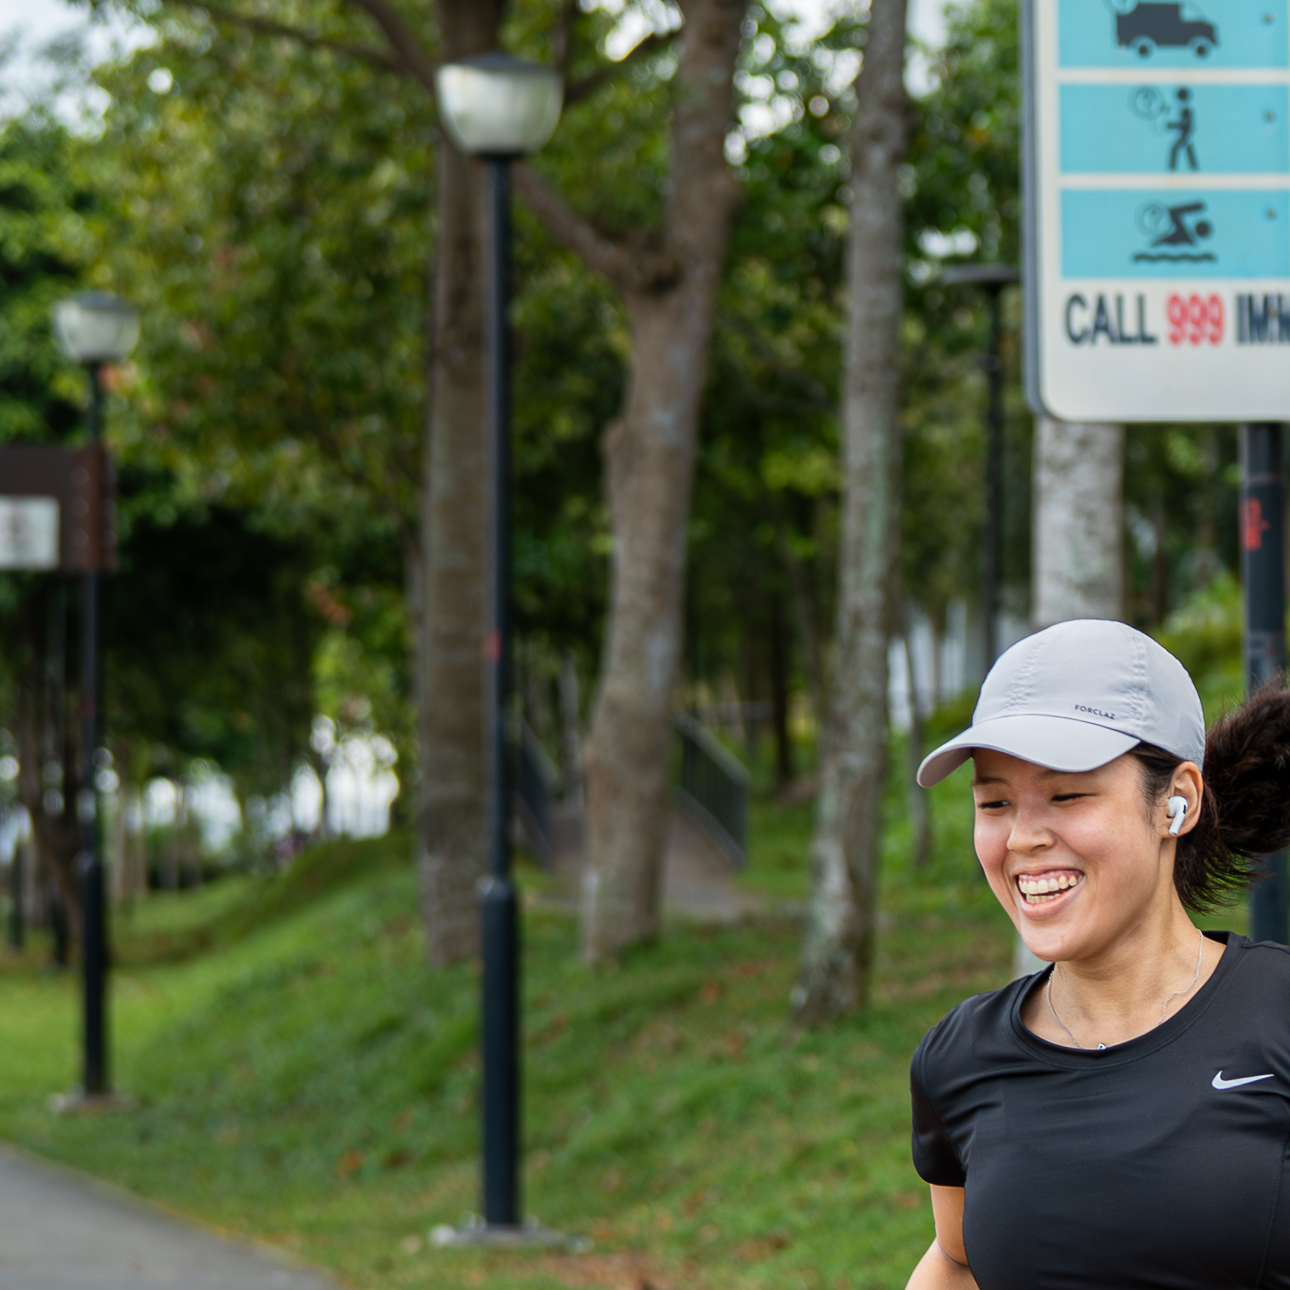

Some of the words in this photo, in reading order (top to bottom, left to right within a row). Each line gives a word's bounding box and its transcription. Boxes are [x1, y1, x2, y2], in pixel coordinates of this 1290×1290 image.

[1065, 293, 1156, 346] CALL
[1166, 293, 1225, 346] 999
[1074, 704, 1116, 720] FORCLAZ
